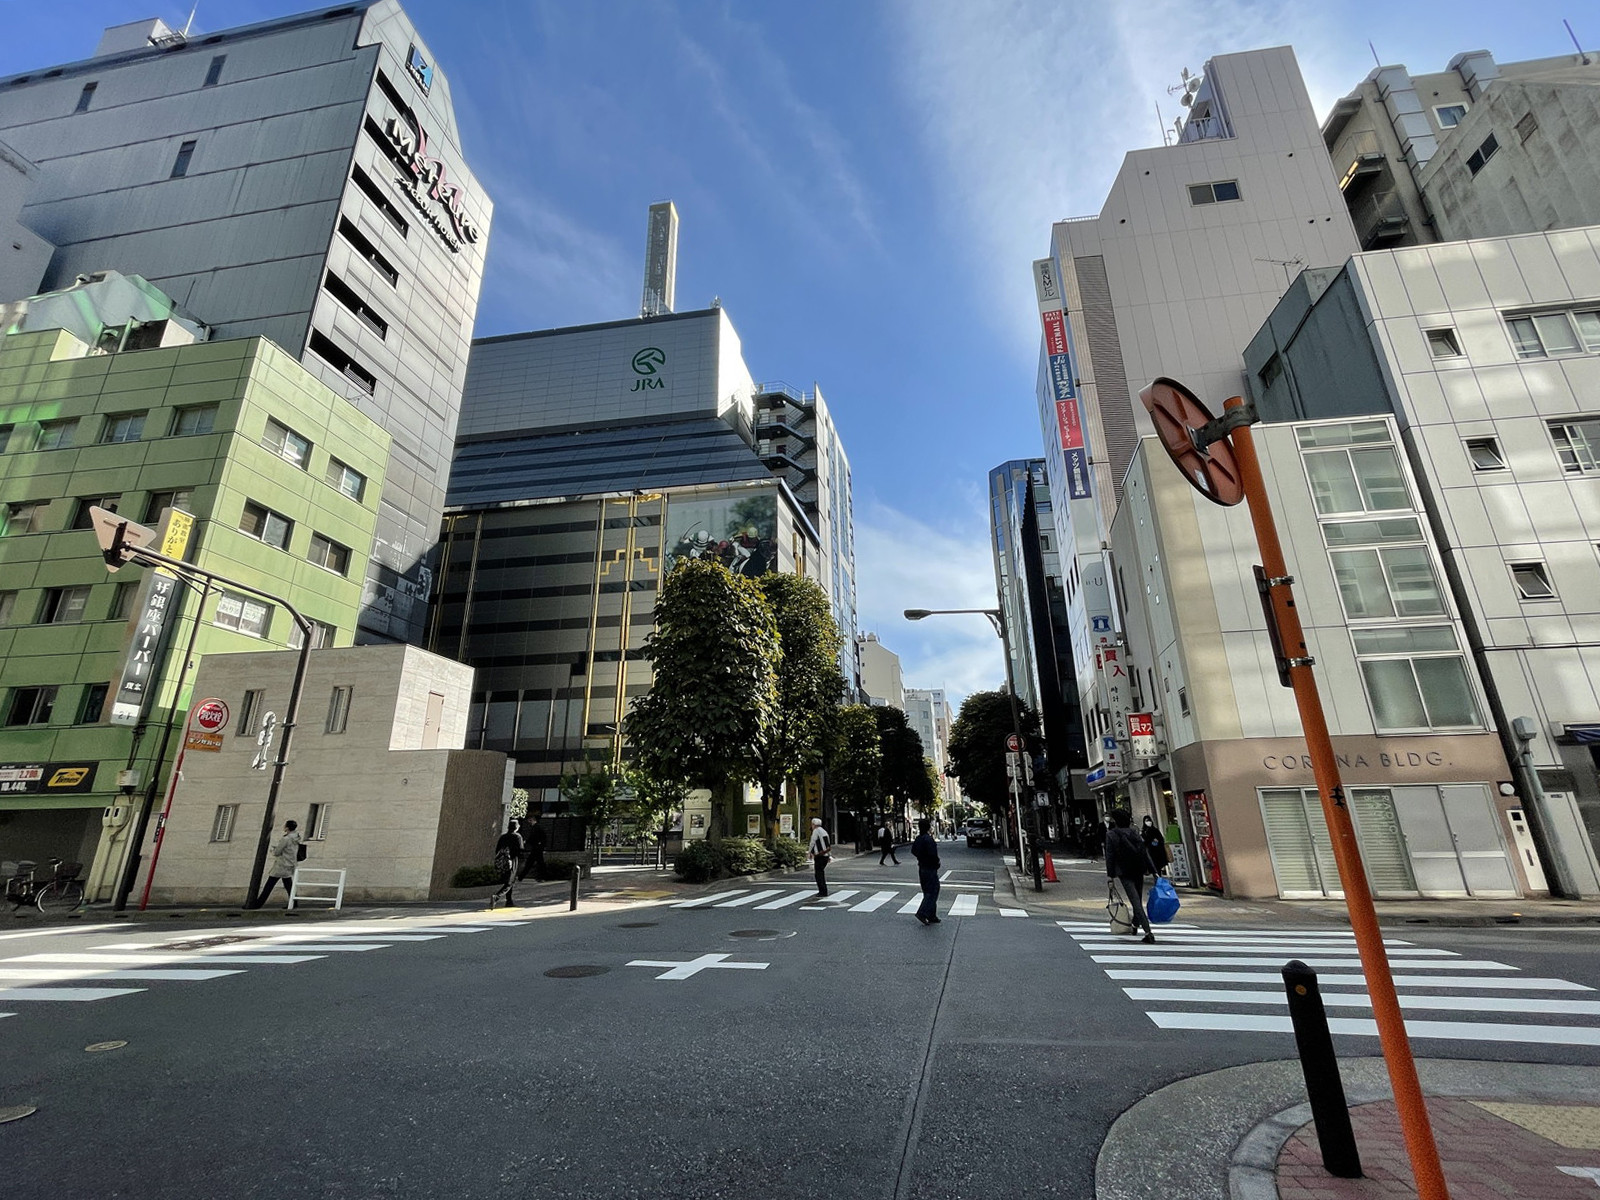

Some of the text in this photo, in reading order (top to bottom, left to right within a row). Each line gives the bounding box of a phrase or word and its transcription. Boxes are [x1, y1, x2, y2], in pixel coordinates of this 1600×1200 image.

[391, 118, 478, 242] Mercure
[630, 377, 664, 391] JRA
[133, 581, 171, 676] ザ銀座バーバー
[1105, 650, 1126, 677] 買入
[1263, 751, 1452, 770] CORNA BLDG.
[56, 775, 80, 784] Times
